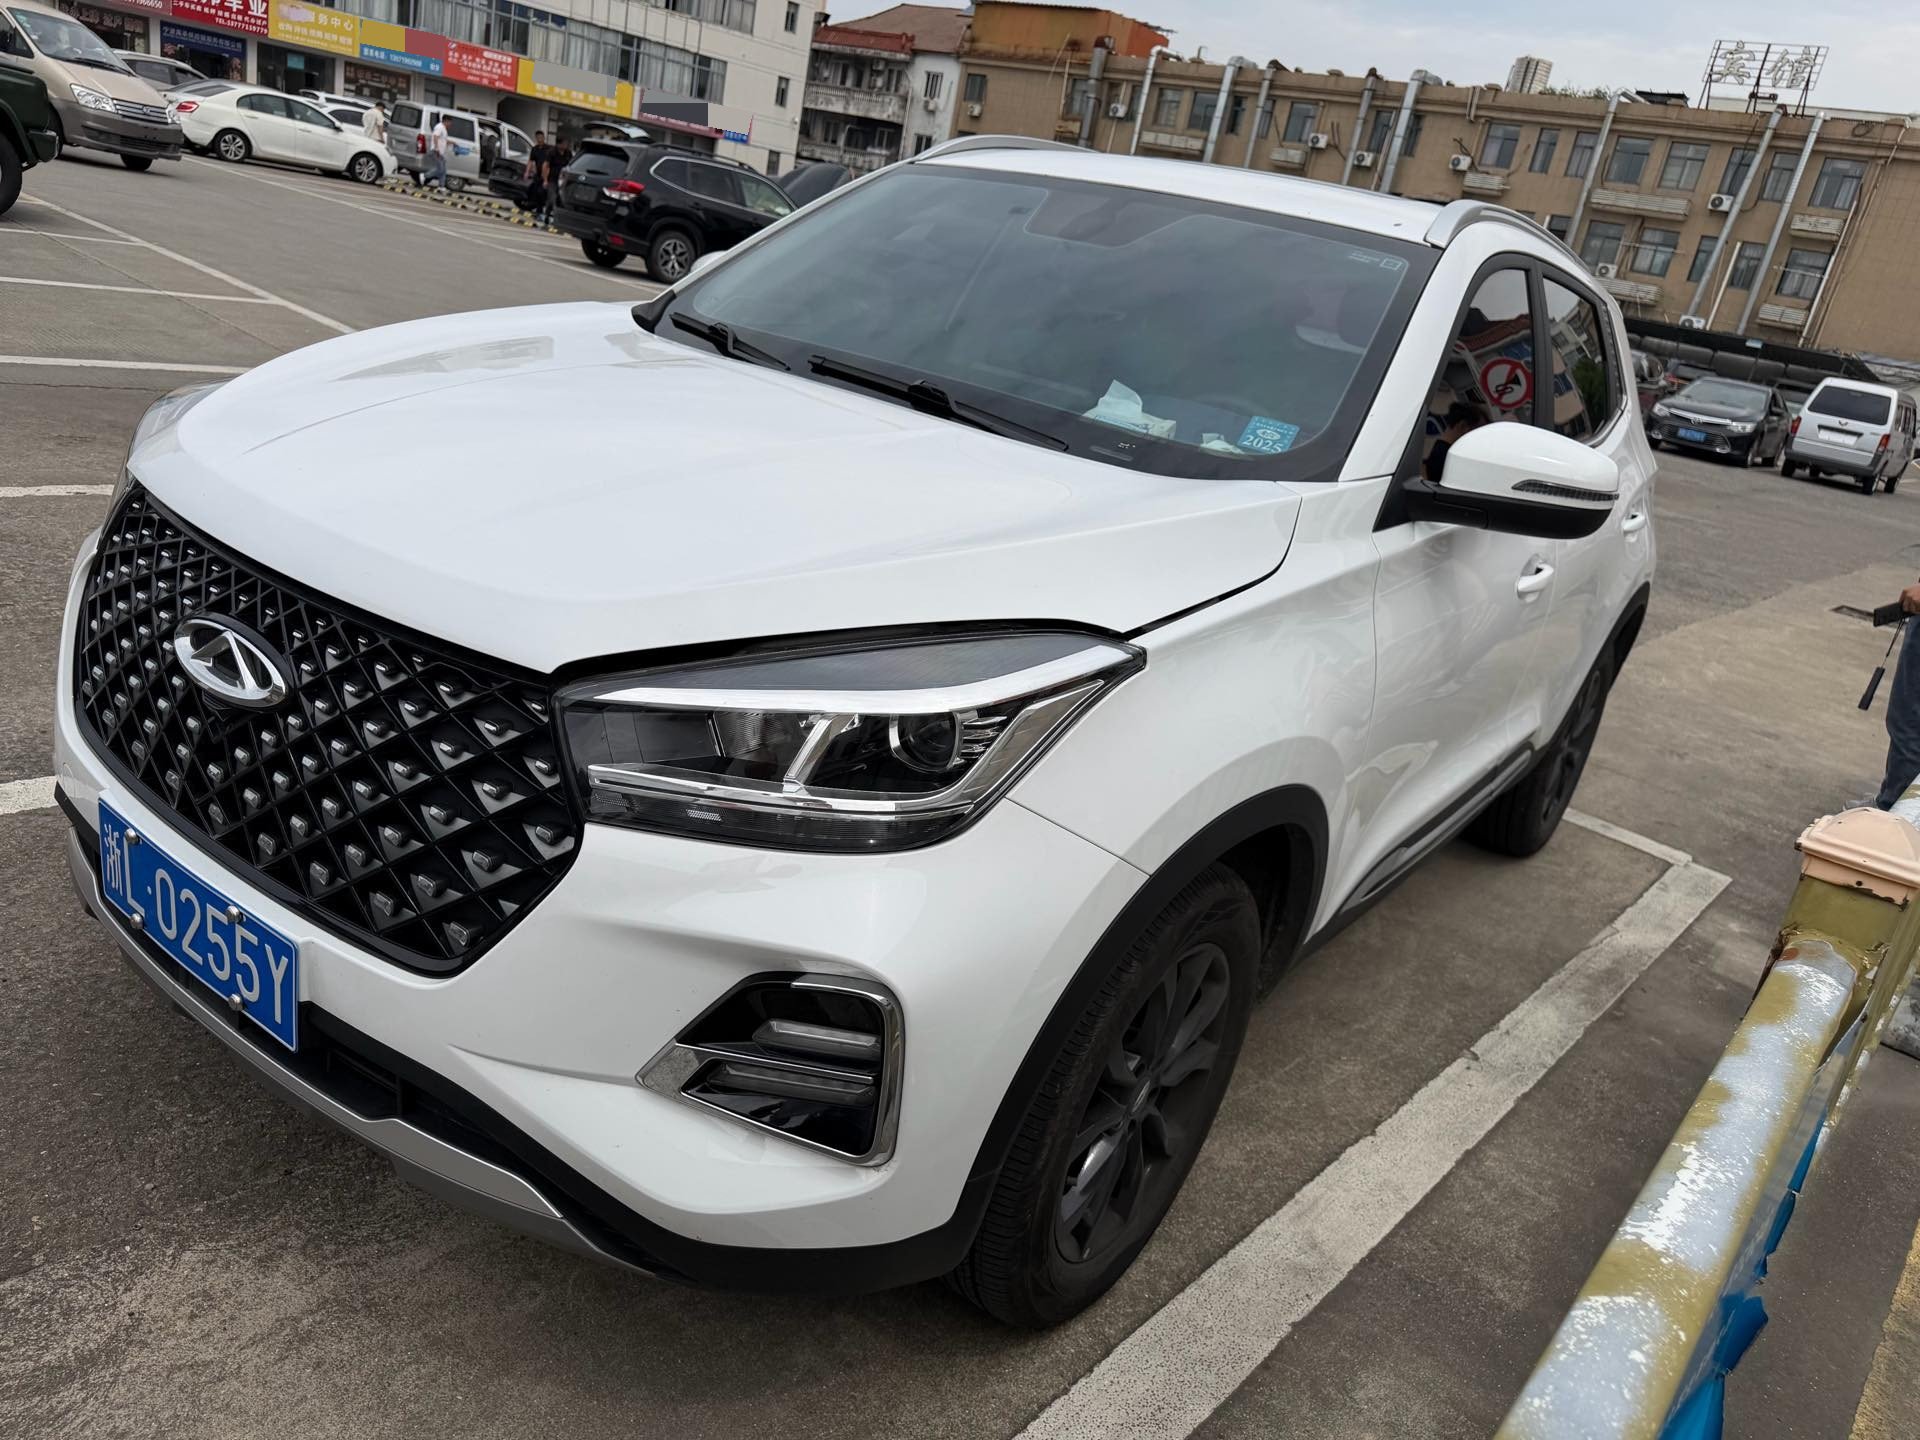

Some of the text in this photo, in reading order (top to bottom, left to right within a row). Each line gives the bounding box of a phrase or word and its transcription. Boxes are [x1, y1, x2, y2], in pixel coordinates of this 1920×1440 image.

[1709, 40, 1815, 88] 宾馆
[1242, 435, 1284, 453] 2025
[104, 823, 288, 1024] 浙L·0255Y
